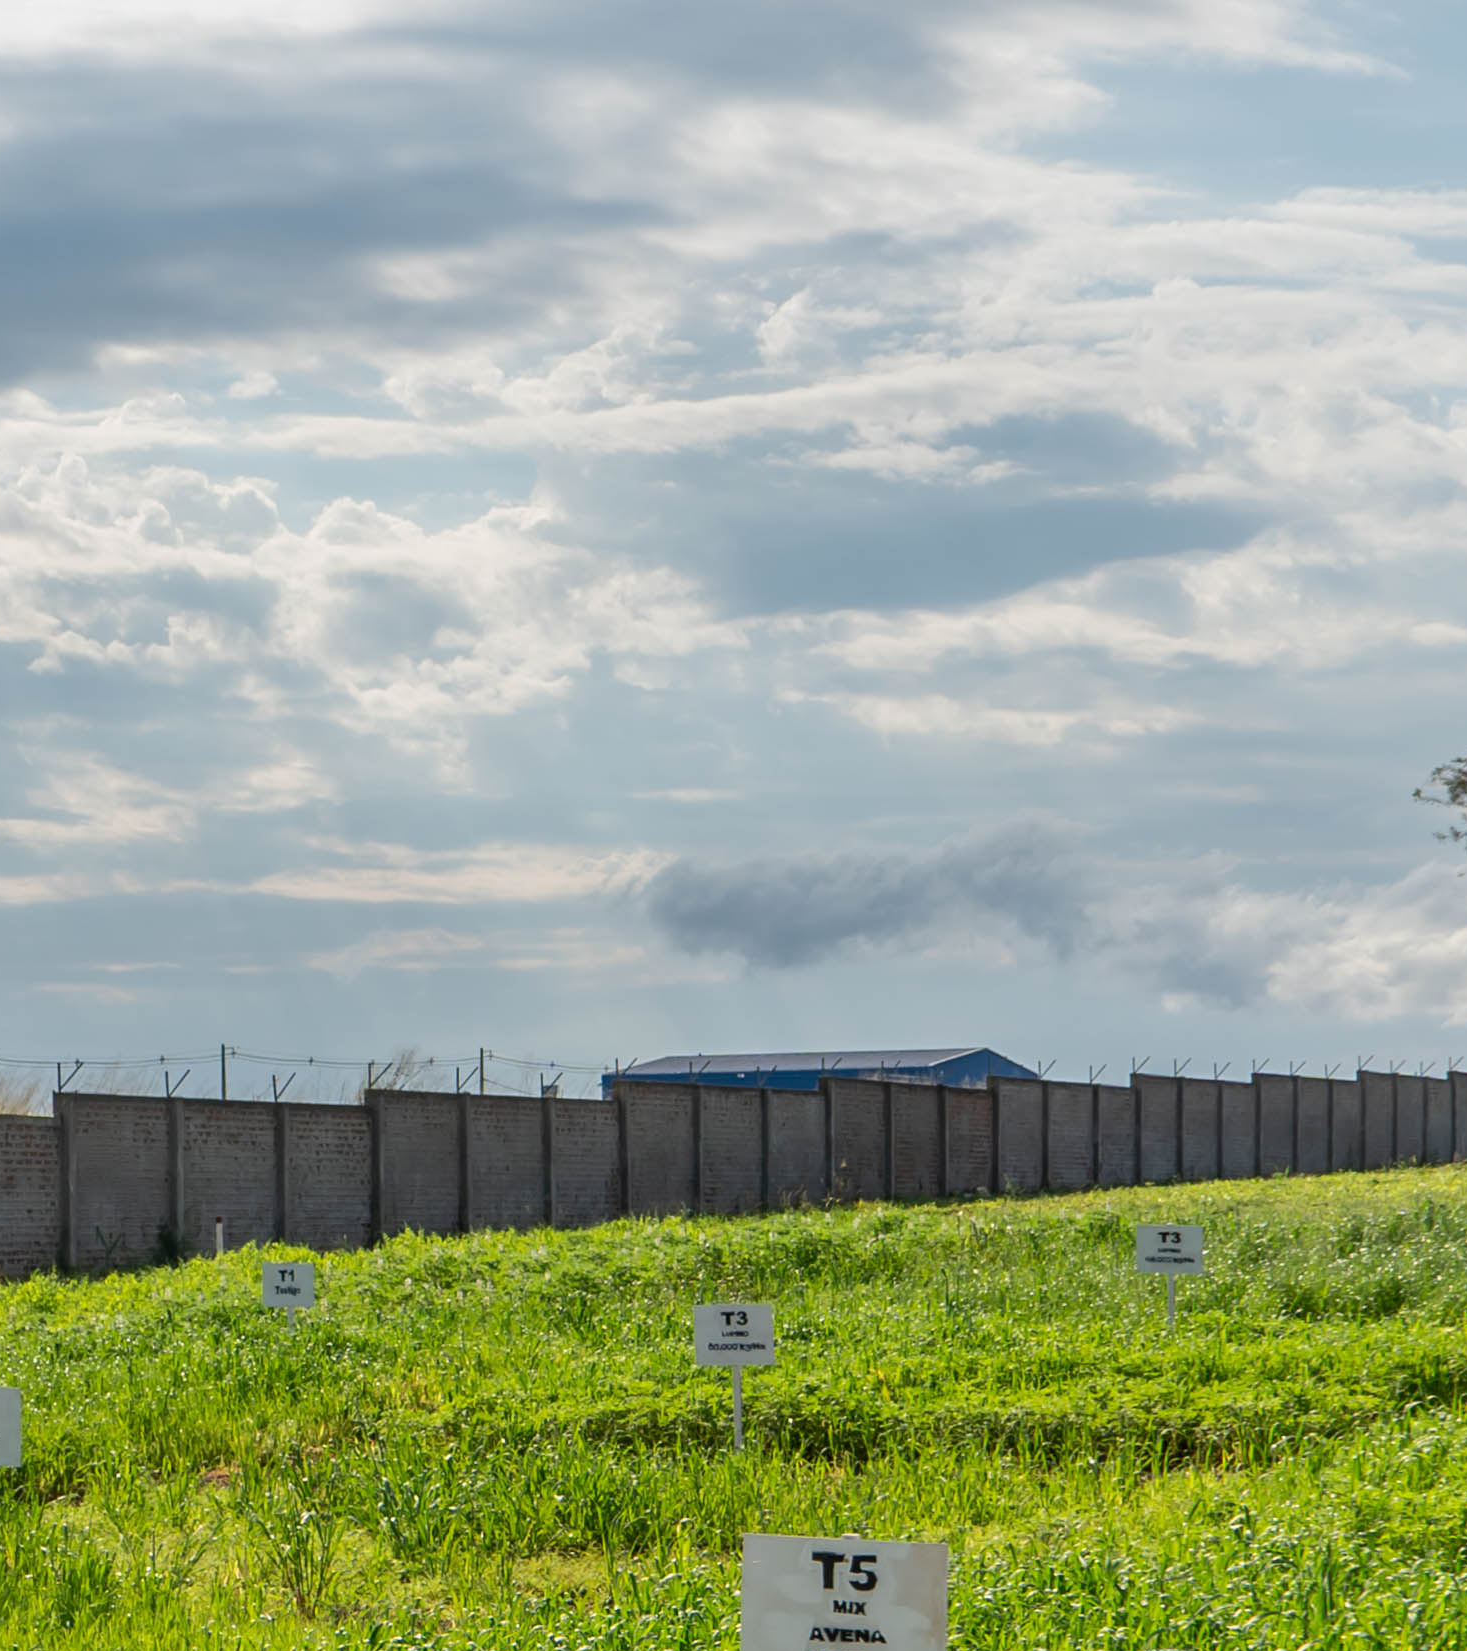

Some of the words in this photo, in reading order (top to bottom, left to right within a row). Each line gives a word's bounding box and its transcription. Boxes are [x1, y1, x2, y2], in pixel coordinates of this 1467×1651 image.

[1157, 1232, 1181, 1243] T3
[278, 1270, 294, 1281] T1
[721, 1311, 748, 1326] T3
[812, 1552, 878, 1591] T5
[833, 1600, 867, 1615] MIX
[809, 1627, 887, 1643] AVENA
